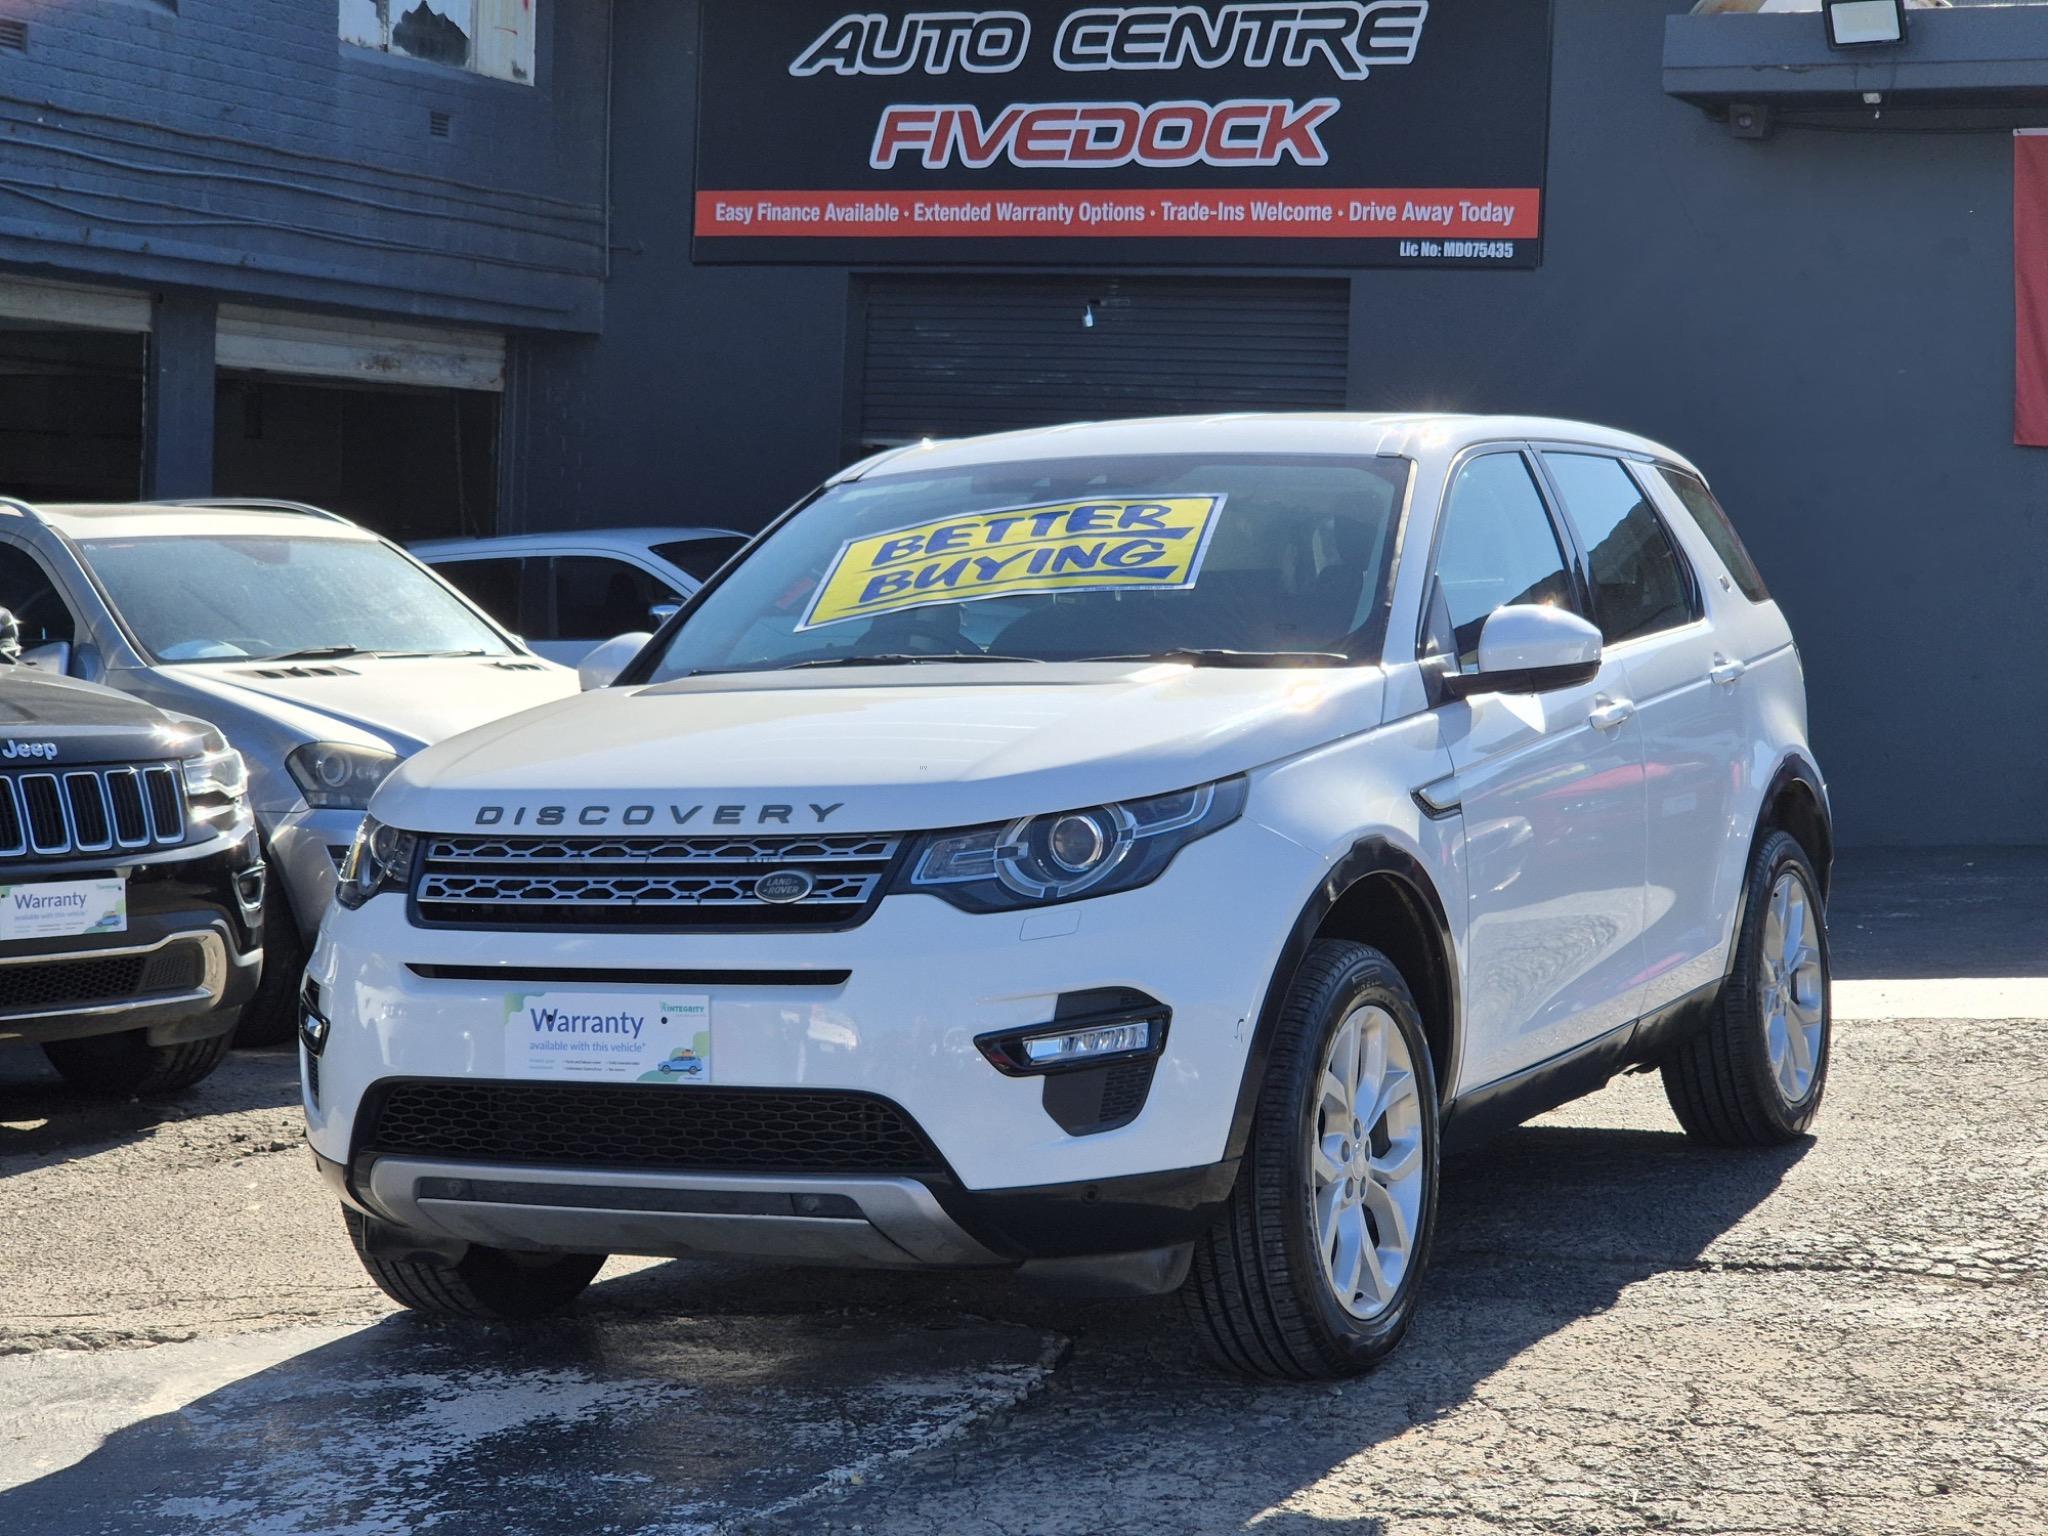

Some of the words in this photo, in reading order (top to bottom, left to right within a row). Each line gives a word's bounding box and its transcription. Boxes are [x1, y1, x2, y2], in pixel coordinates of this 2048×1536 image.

[788, 11, 1031, 76] AUTO
[1053, 0, 1429, 80] CENTRE
[869, 98, 1340, 169] FIVEDOCK
[715, 202, 752, 224] Easy
[757, 202, 820, 221] Finance
[824, 202, 899, 221] Available
[914, 202, 991, 221] Extended
[996, 202, 1074, 224] Warranty
[1078, 201, 1145, 224] Options
[1161, 201, 1245, 221] Trade-Ins
[1250, 201, 1333, 221] Welcome
[1350, 201, 1397, 221] Drive
[1401, 201, 1454, 225] Away
[1459, 201, 1515, 226] Today
[1400, 241, 1418, 257] Lic
[1420, 241, 1441, 257] No:
[1443, 241, 1513, 258] MD075435
[871, 504, 1171, 567] BETTER
[859, 539, 1165, 603] BUYING
[2, 739, 58, 760] Jeep
[475, 803, 844, 826] DISCOVERY
[14, 892, 88, 910] Warranty
[530, 1007, 645, 1039] Warranty
[529, 1041, 568, 1051] available
[570, 1042, 590, 1052] with
[592, 1042, 609, 1052] this
